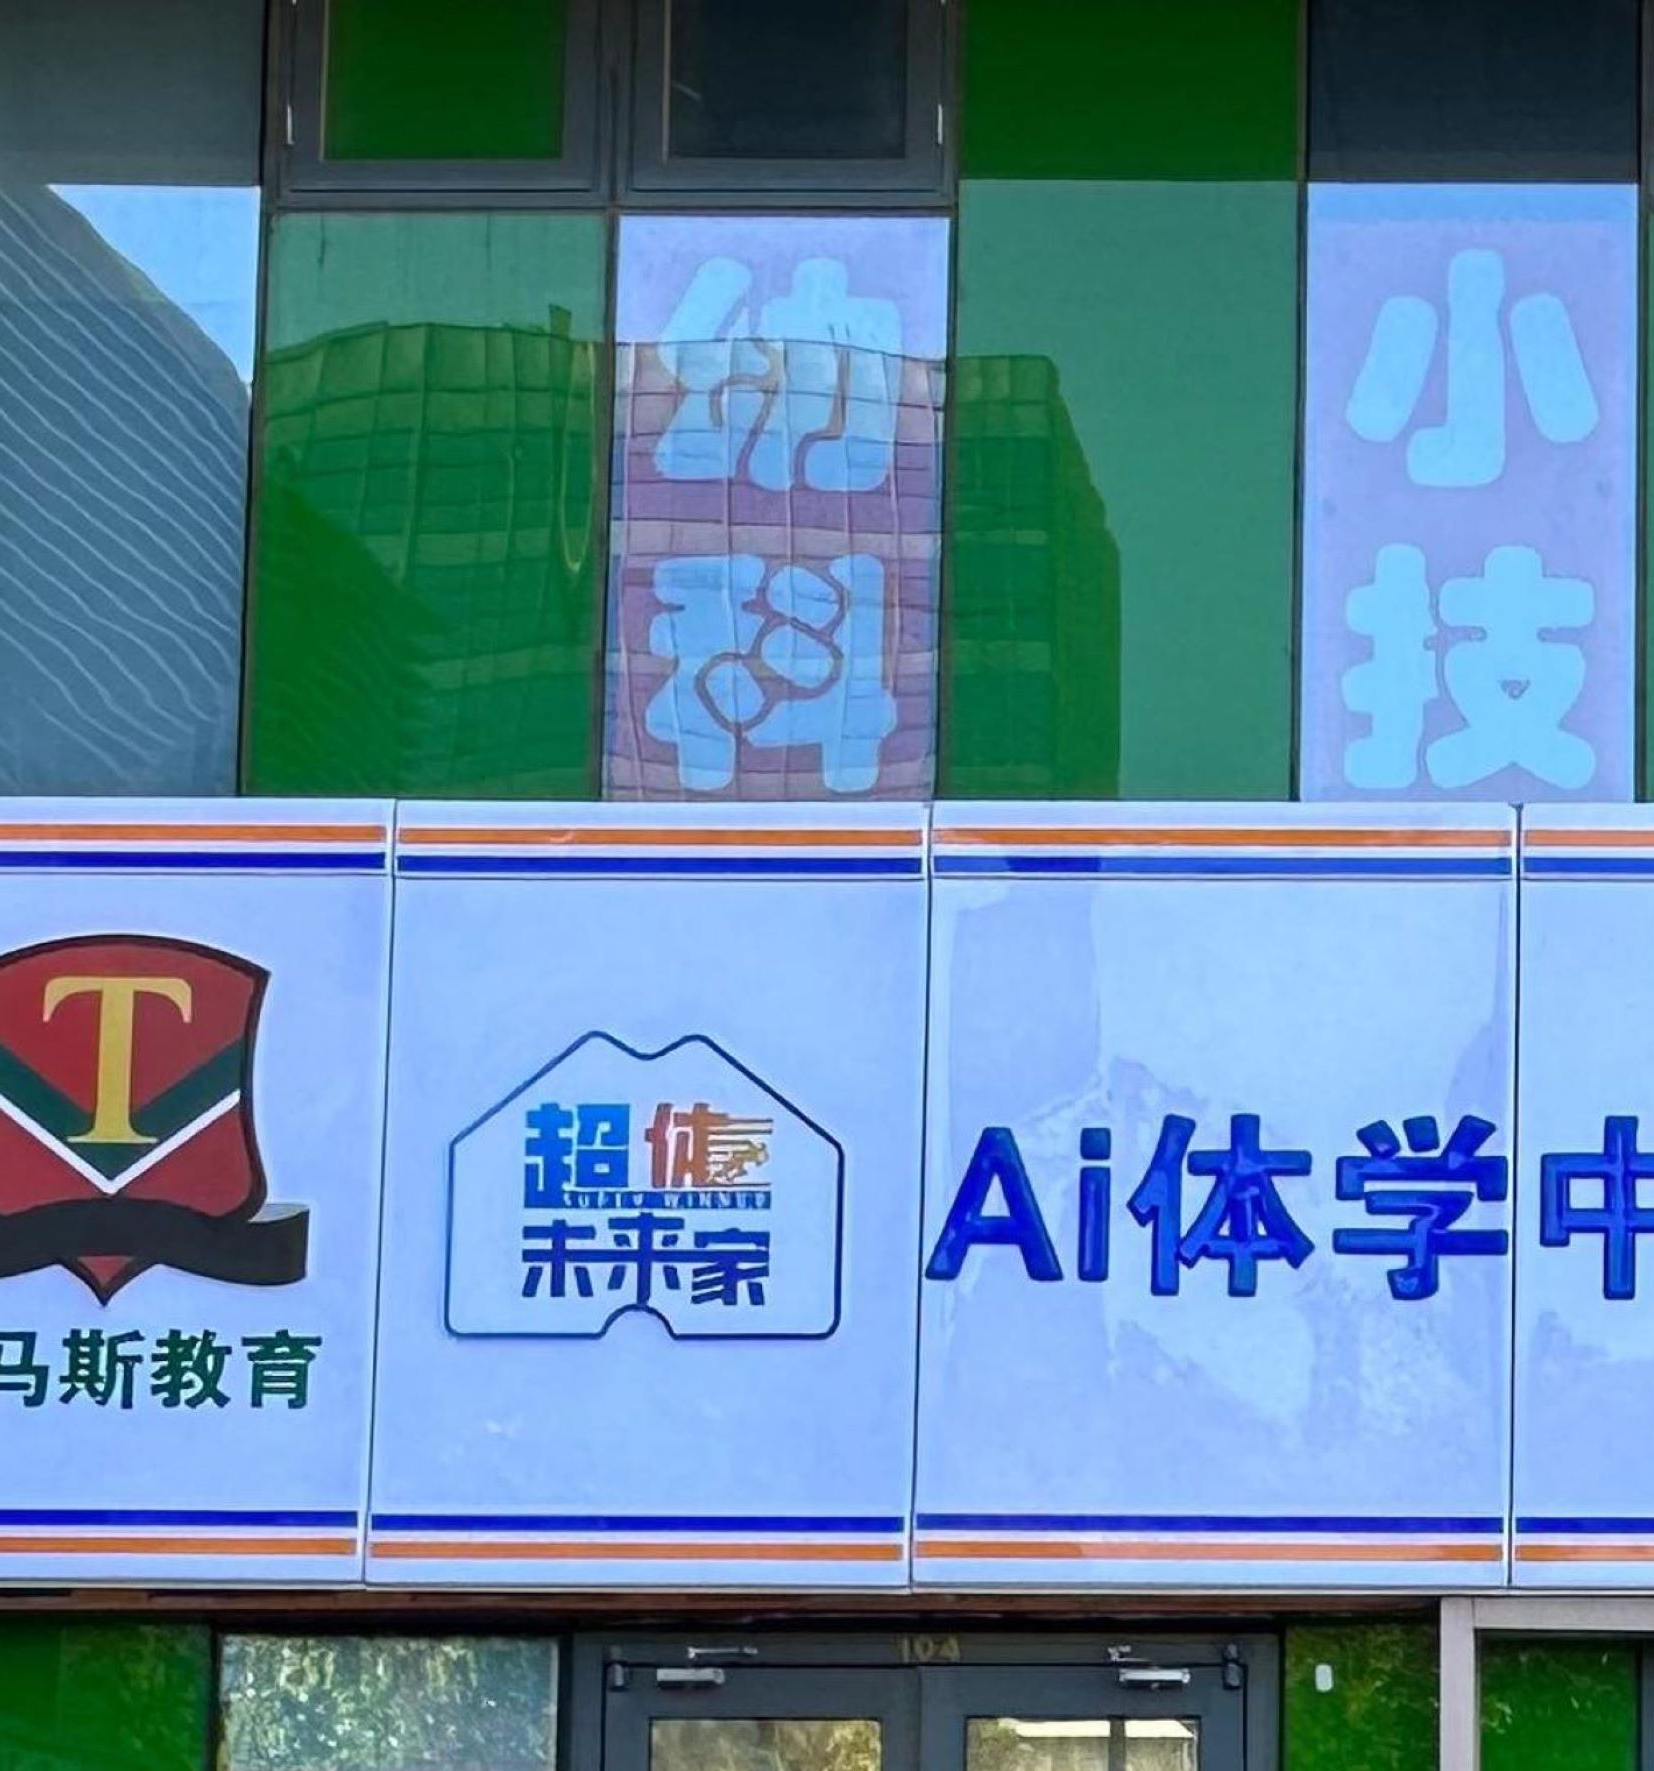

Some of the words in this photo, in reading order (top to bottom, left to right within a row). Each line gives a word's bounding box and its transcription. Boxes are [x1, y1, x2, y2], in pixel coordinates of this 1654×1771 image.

[42, 975, 192, 1145] T
[522, 1212, 770, 1305] 未来家
[897, 1636, 961, 1661] 104
